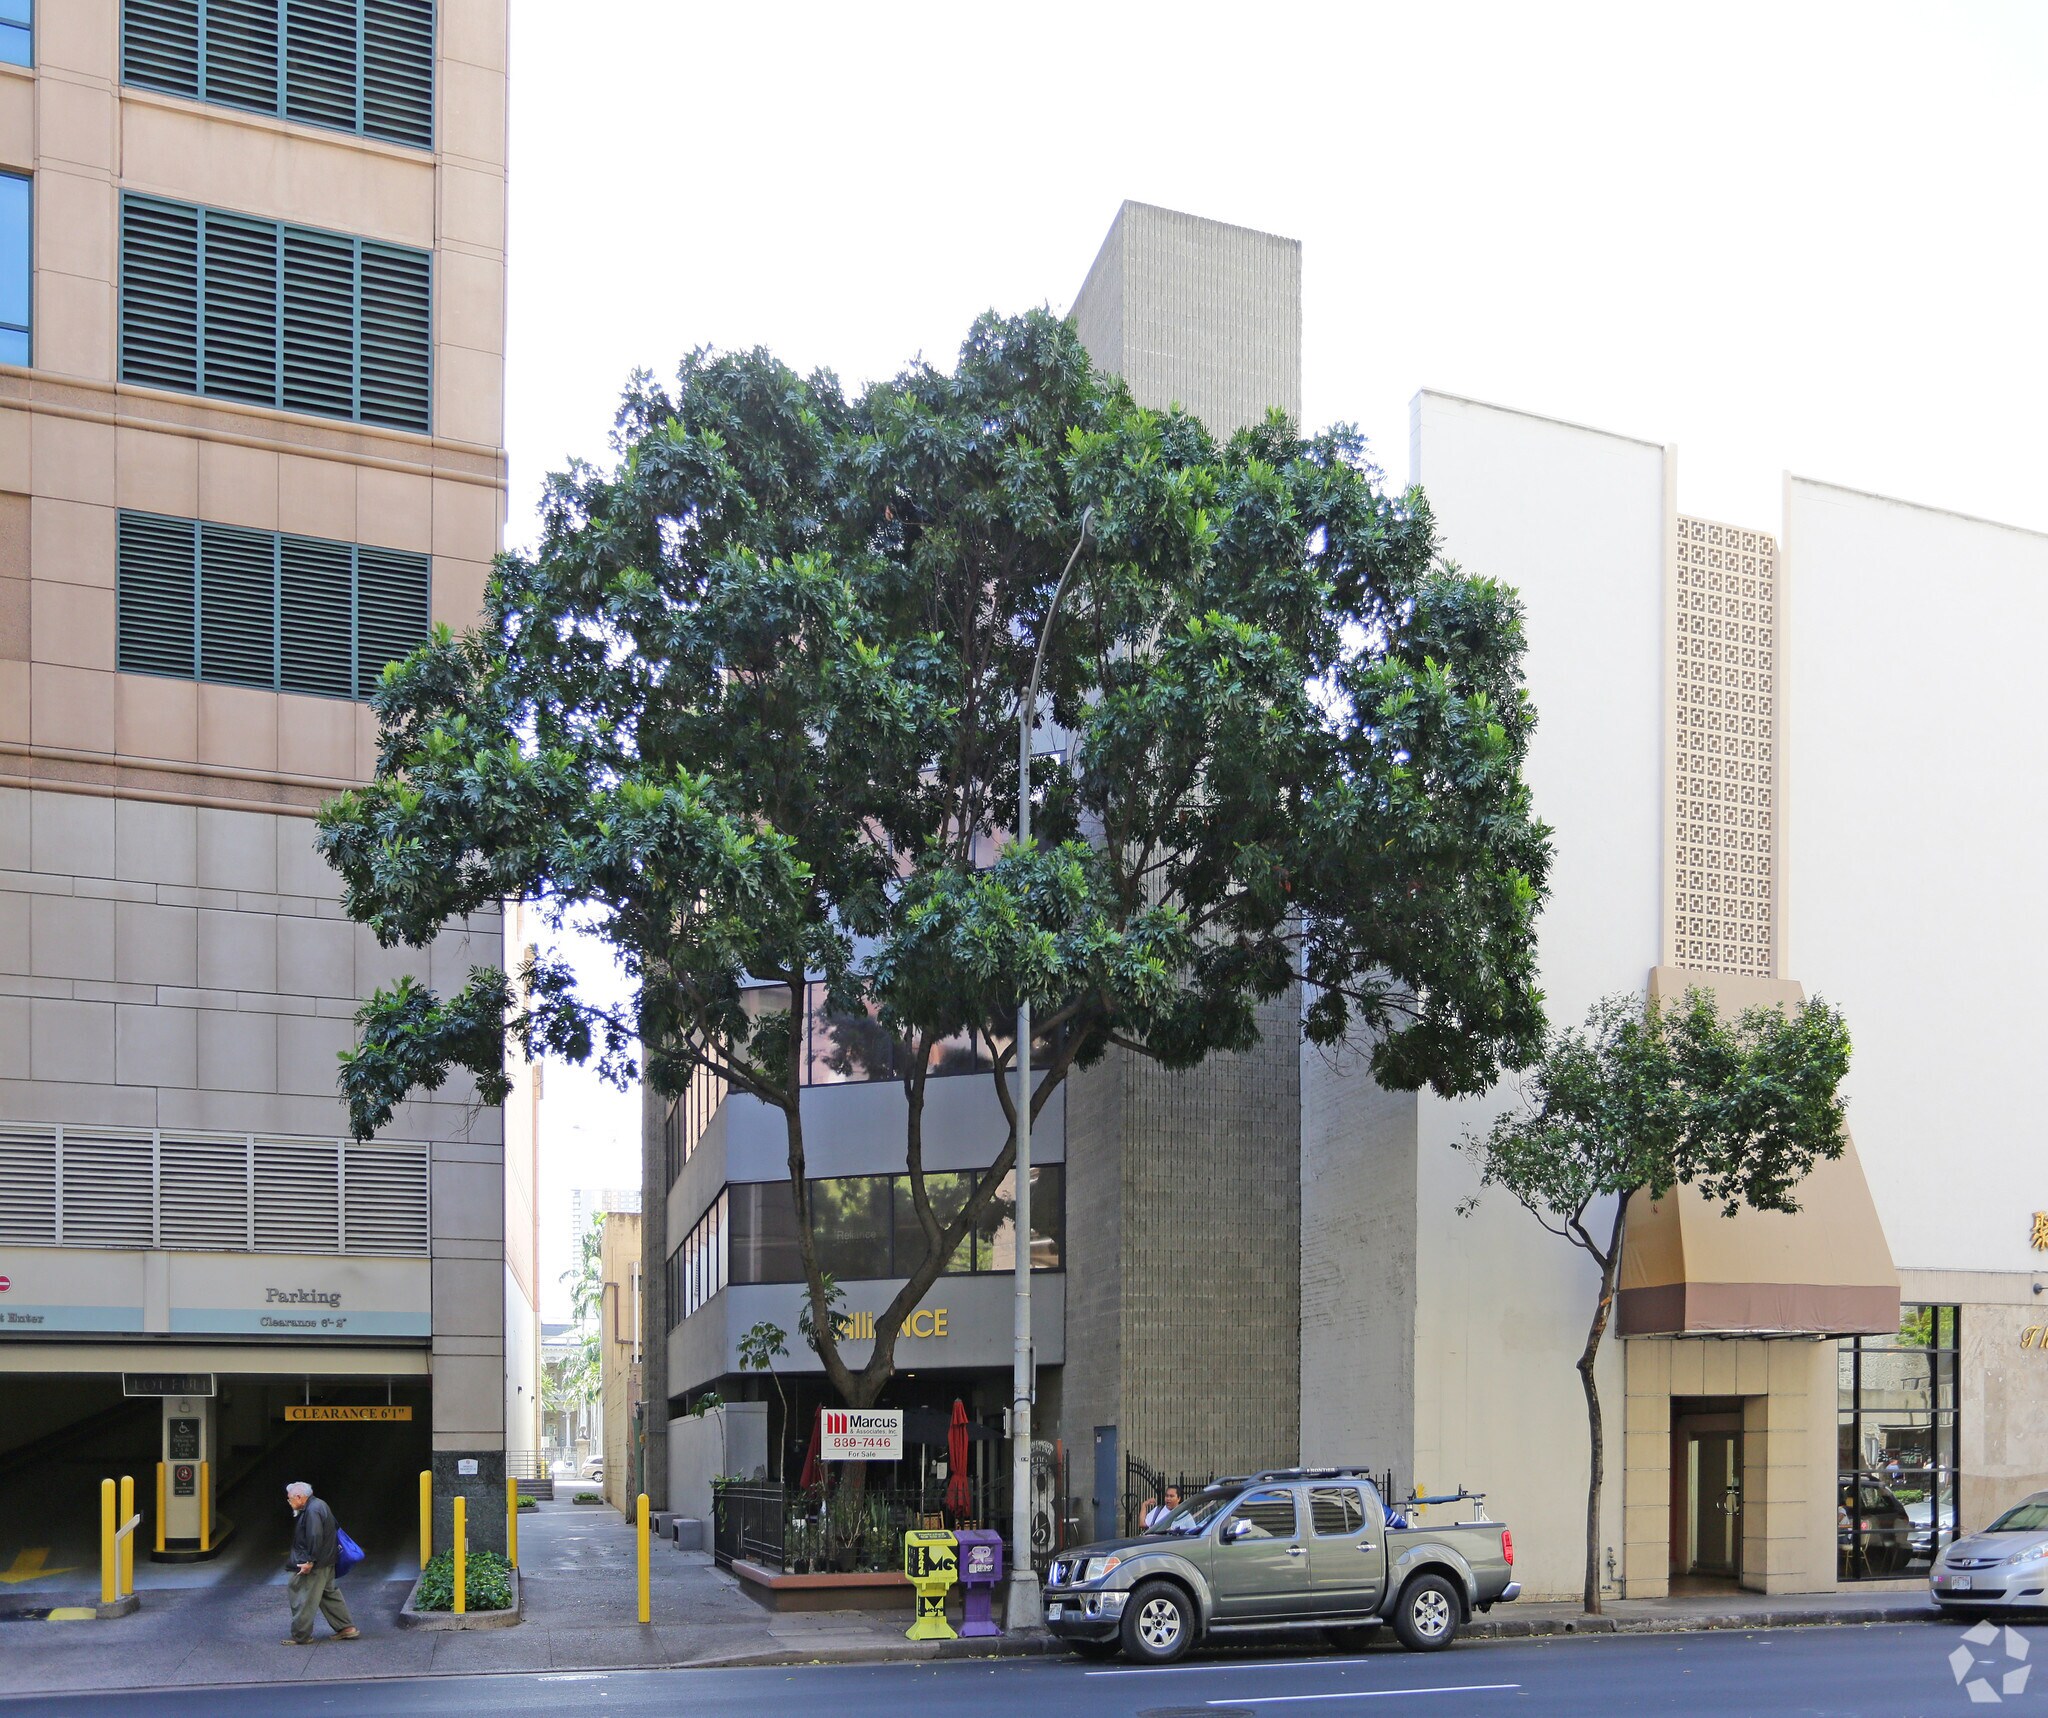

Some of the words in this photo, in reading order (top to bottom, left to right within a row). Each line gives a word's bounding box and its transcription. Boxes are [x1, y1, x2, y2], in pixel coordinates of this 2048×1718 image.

[265, 1287, 341, 1308] Parking
[8, 1312, 44, 1323] Enter
[260, 1317, 316, 1327] Clearance
[834, 1308, 948, 1340] AlliNCE
[134, 1377, 163, 1391] LOT
[172, 1377, 210, 1391] FULL
[292, 1408, 377, 1419] CLEARANCE
[381, 1408, 404, 1419] 6'1"
[850, 1415, 897, 1428] Marcus
[833, 1437, 891, 1448] 839-7446
